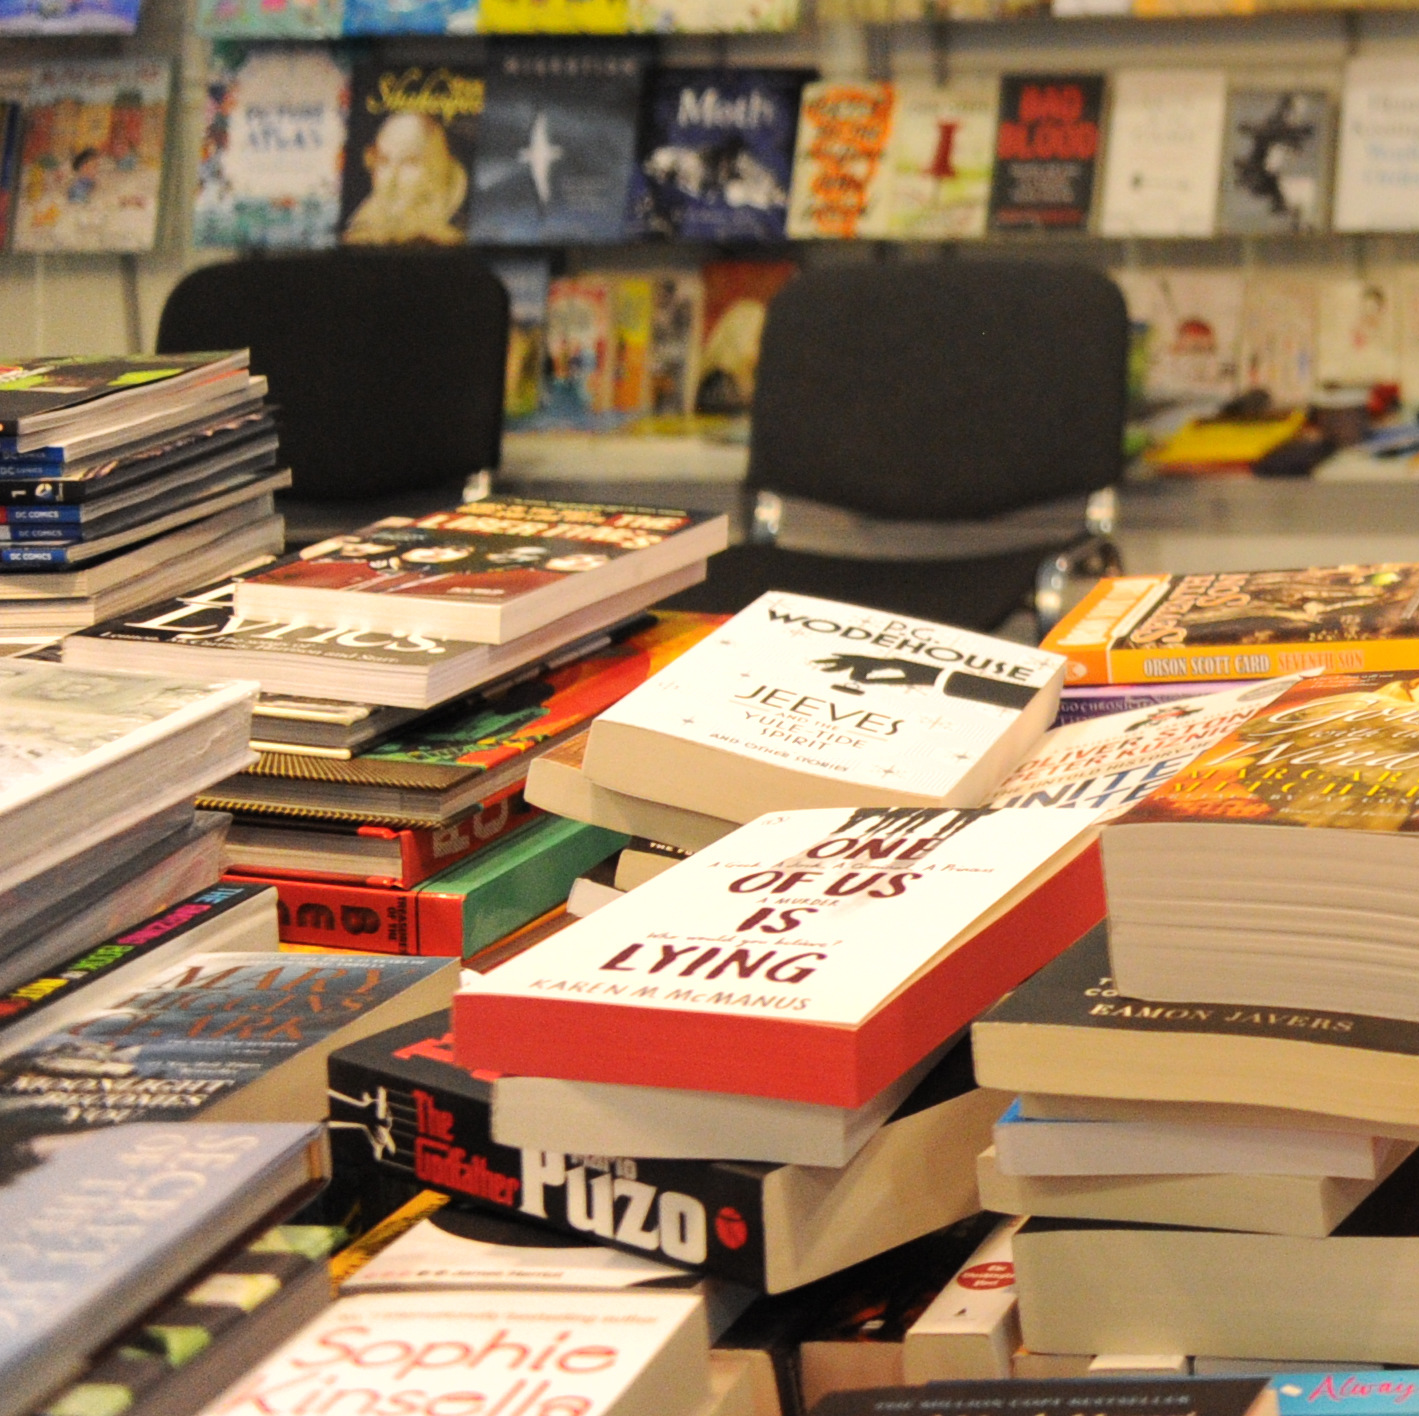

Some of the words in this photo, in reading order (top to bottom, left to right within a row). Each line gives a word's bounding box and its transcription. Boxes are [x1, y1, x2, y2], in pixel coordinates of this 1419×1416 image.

[677, 88, 776, 131] Moth
[1020, 85, 1085, 116] BAD
[245, 125, 326, 150] ATLAS
[1000, 121, 1101, 159] BLOOD
[767, 609, 1034, 683] WODEHOUSE
[1144, 656, 1187, 678] ORSON
[1190, 654, 1231, 676] SCOTT
[1233, 652, 1271, 675] CARD
[1277, 651, 1336, 672] SEVENTH
[1338, 650, 1365, 670] SON
[734, 684, 905, 738] JEEVES
[743, 711, 869, 751] YULE-TIDE
[760, 727, 837, 753] SPIRIT
[1017, 736, 1143, 773] OLIVER
[804, 836, 944, 863] ONE
[726, 870, 818, 896] OF
[824, 870, 924, 899] US
[736, 906, 820, 934] IS
[150, 964, 384, 994] MARY
[599, 942, 829, 986] LYING
[529, 976, 627, 997] KAREN
[1088, 1000, 1214, 1024] EAMON
[1224, 1008, 1355, 1033] JAVERS
[288, 1324, 619, 1381] Sophie
[212, 1374, 596, 1416] Kinsella
